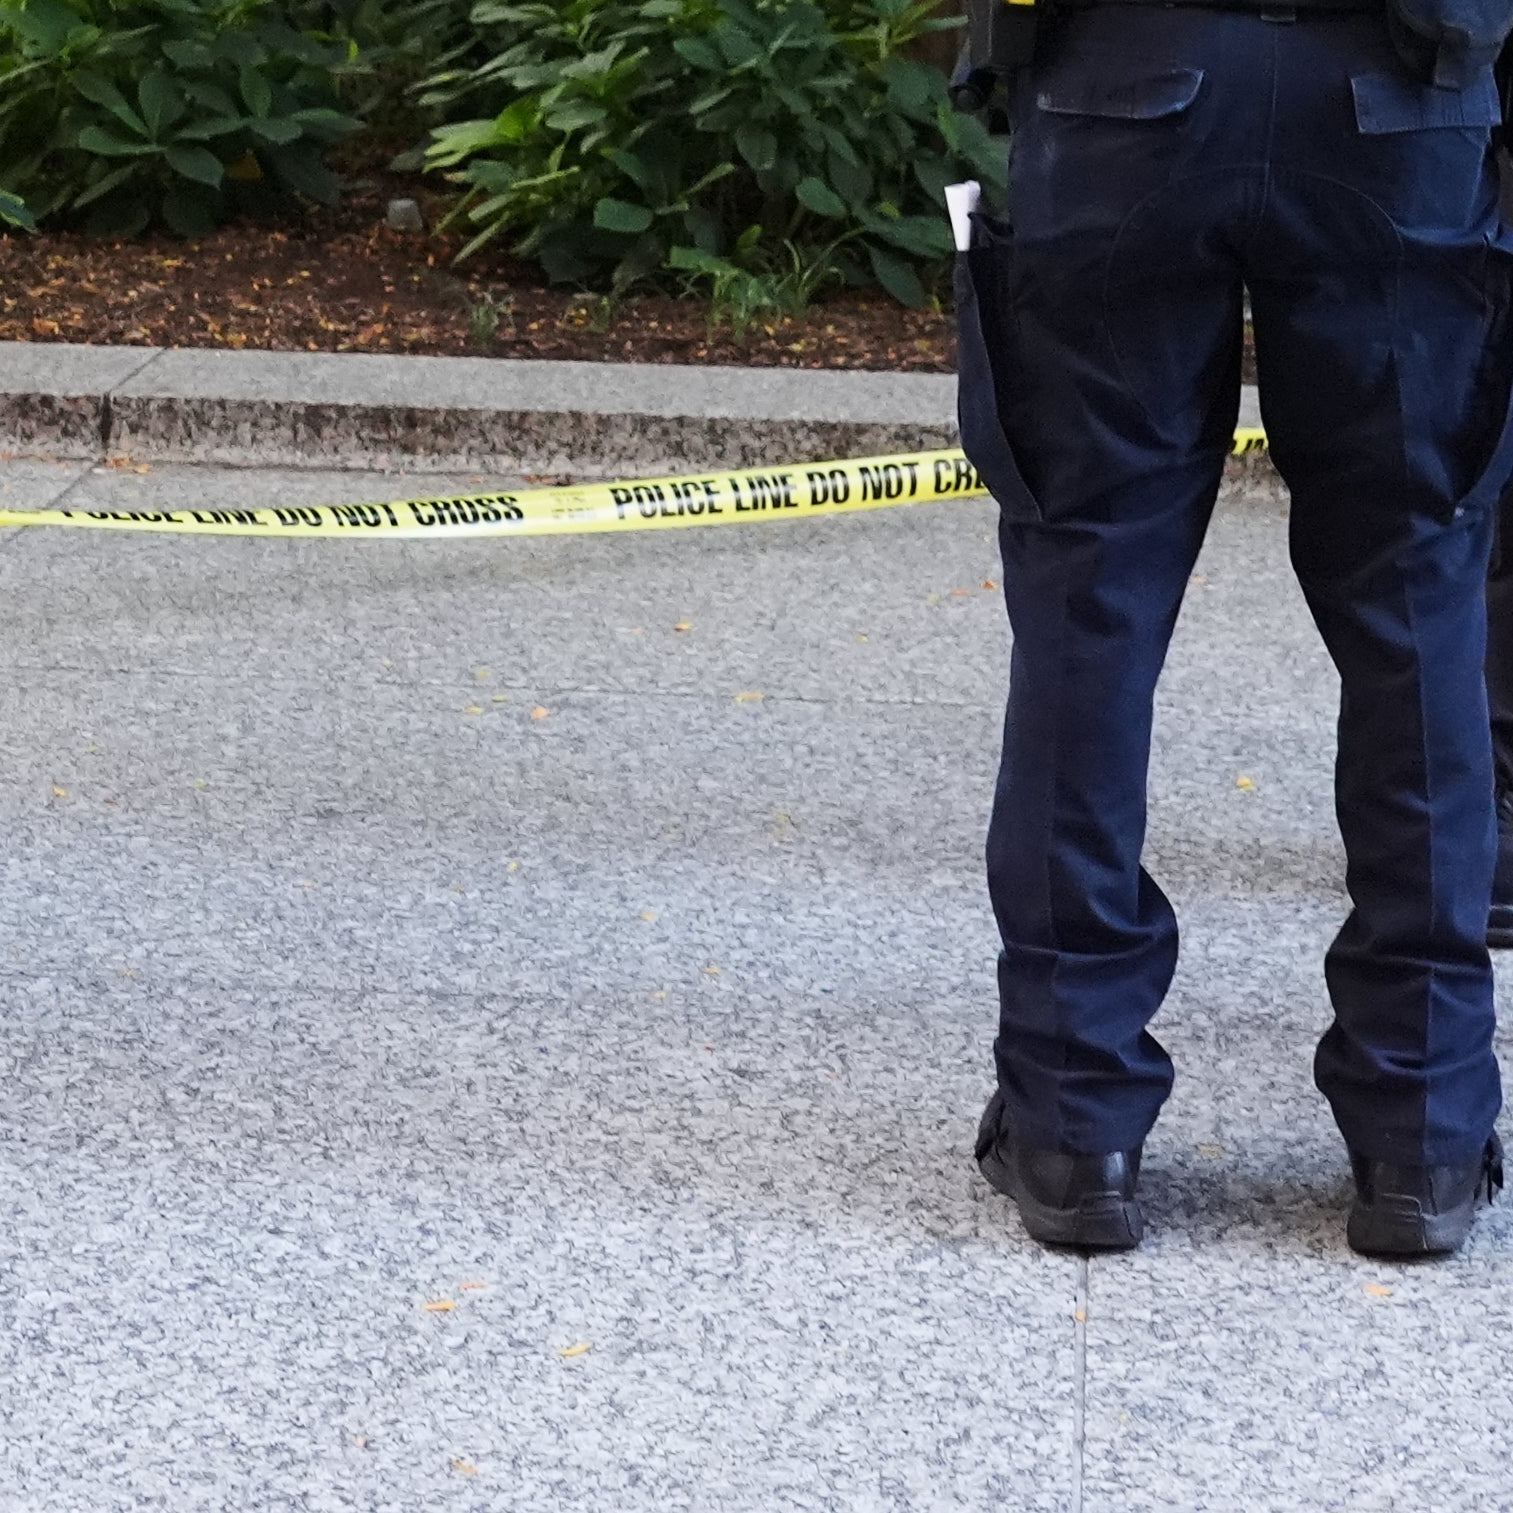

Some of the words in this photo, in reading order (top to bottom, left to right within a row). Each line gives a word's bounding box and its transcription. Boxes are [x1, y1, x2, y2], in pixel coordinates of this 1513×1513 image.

[272, 507, 322, 527] DO
[329, 503, 399, 527] NOT
[407, 495, 524, 527] CROSS
[608, 479, 724, 520] POLICE
[727, 473, 799, 512] LINE
[807, 469, 850, 506] DO
[858, 461, 920, 502] NOT
